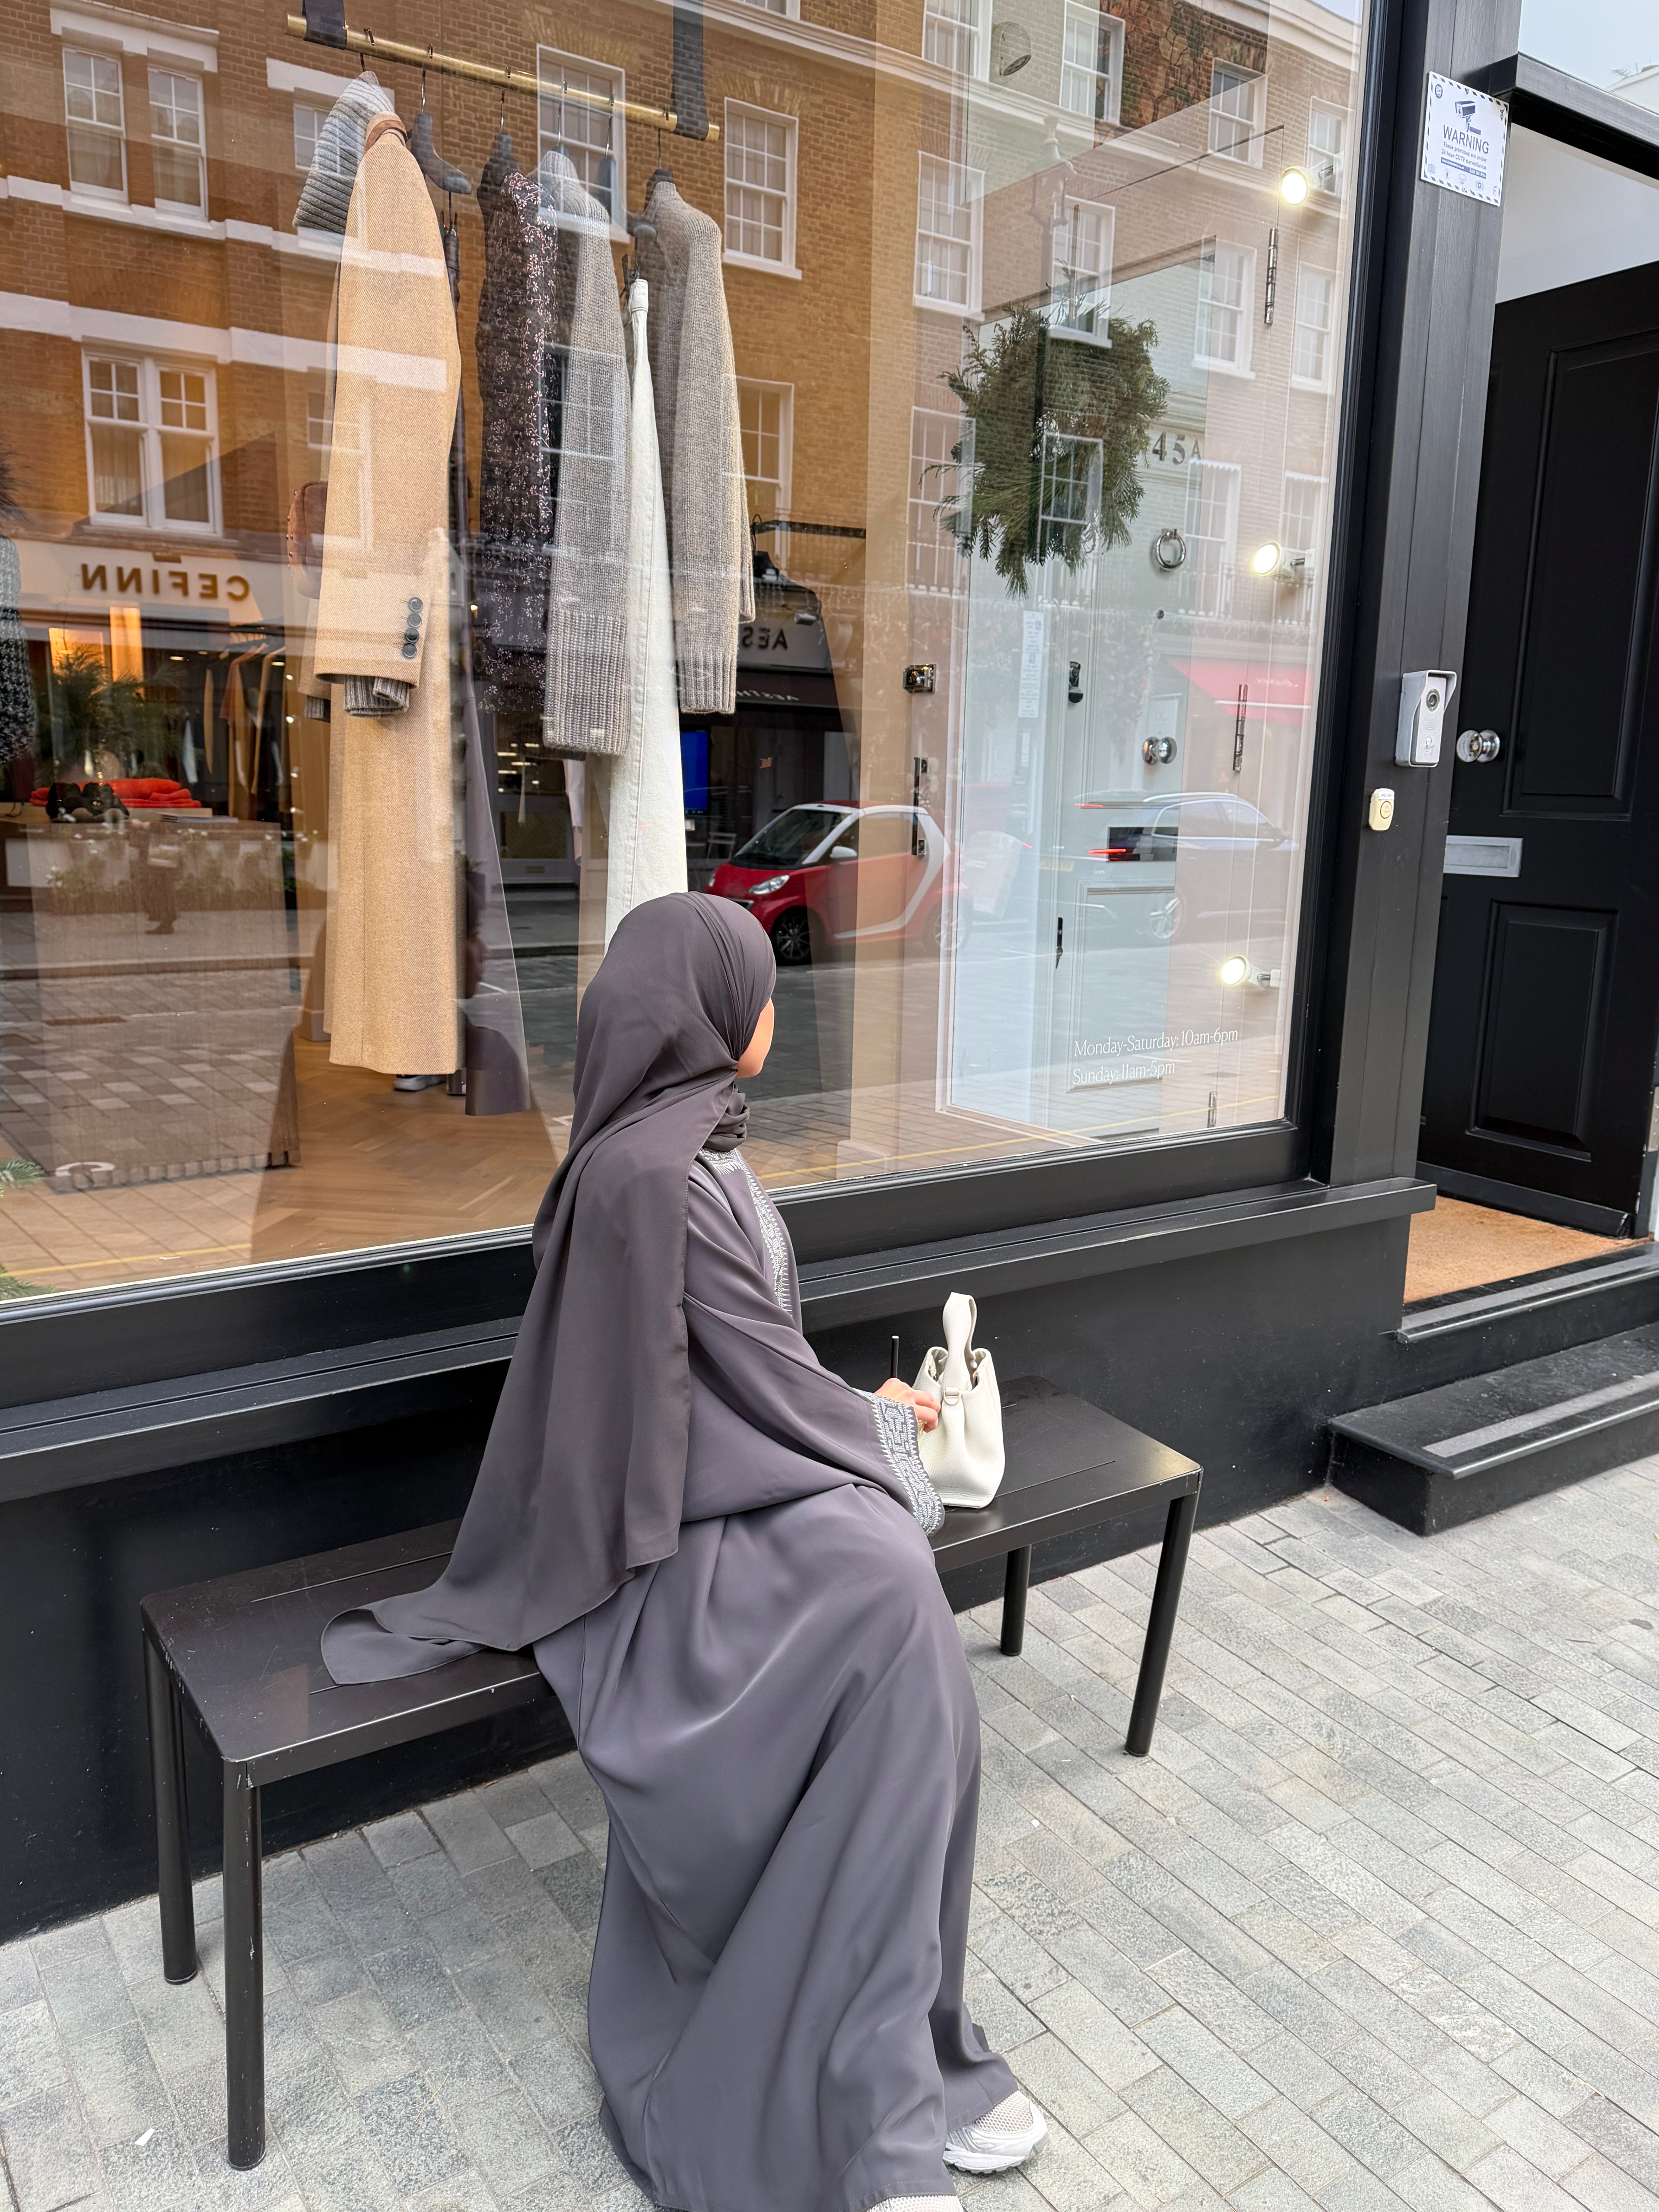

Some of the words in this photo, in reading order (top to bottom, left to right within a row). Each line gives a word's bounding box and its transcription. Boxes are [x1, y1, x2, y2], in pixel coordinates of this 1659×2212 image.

[1443, 124, 1489, 154] WARNING
[1074, 1032, 1179, 1057] Monday-Saturday:
[1181, 1027, 1239, 1046] 10am-6pm
[1072, 1064, 1119, 1085] Sunday:
[1122, 1060, 1176, 1080] 11am-5pm
